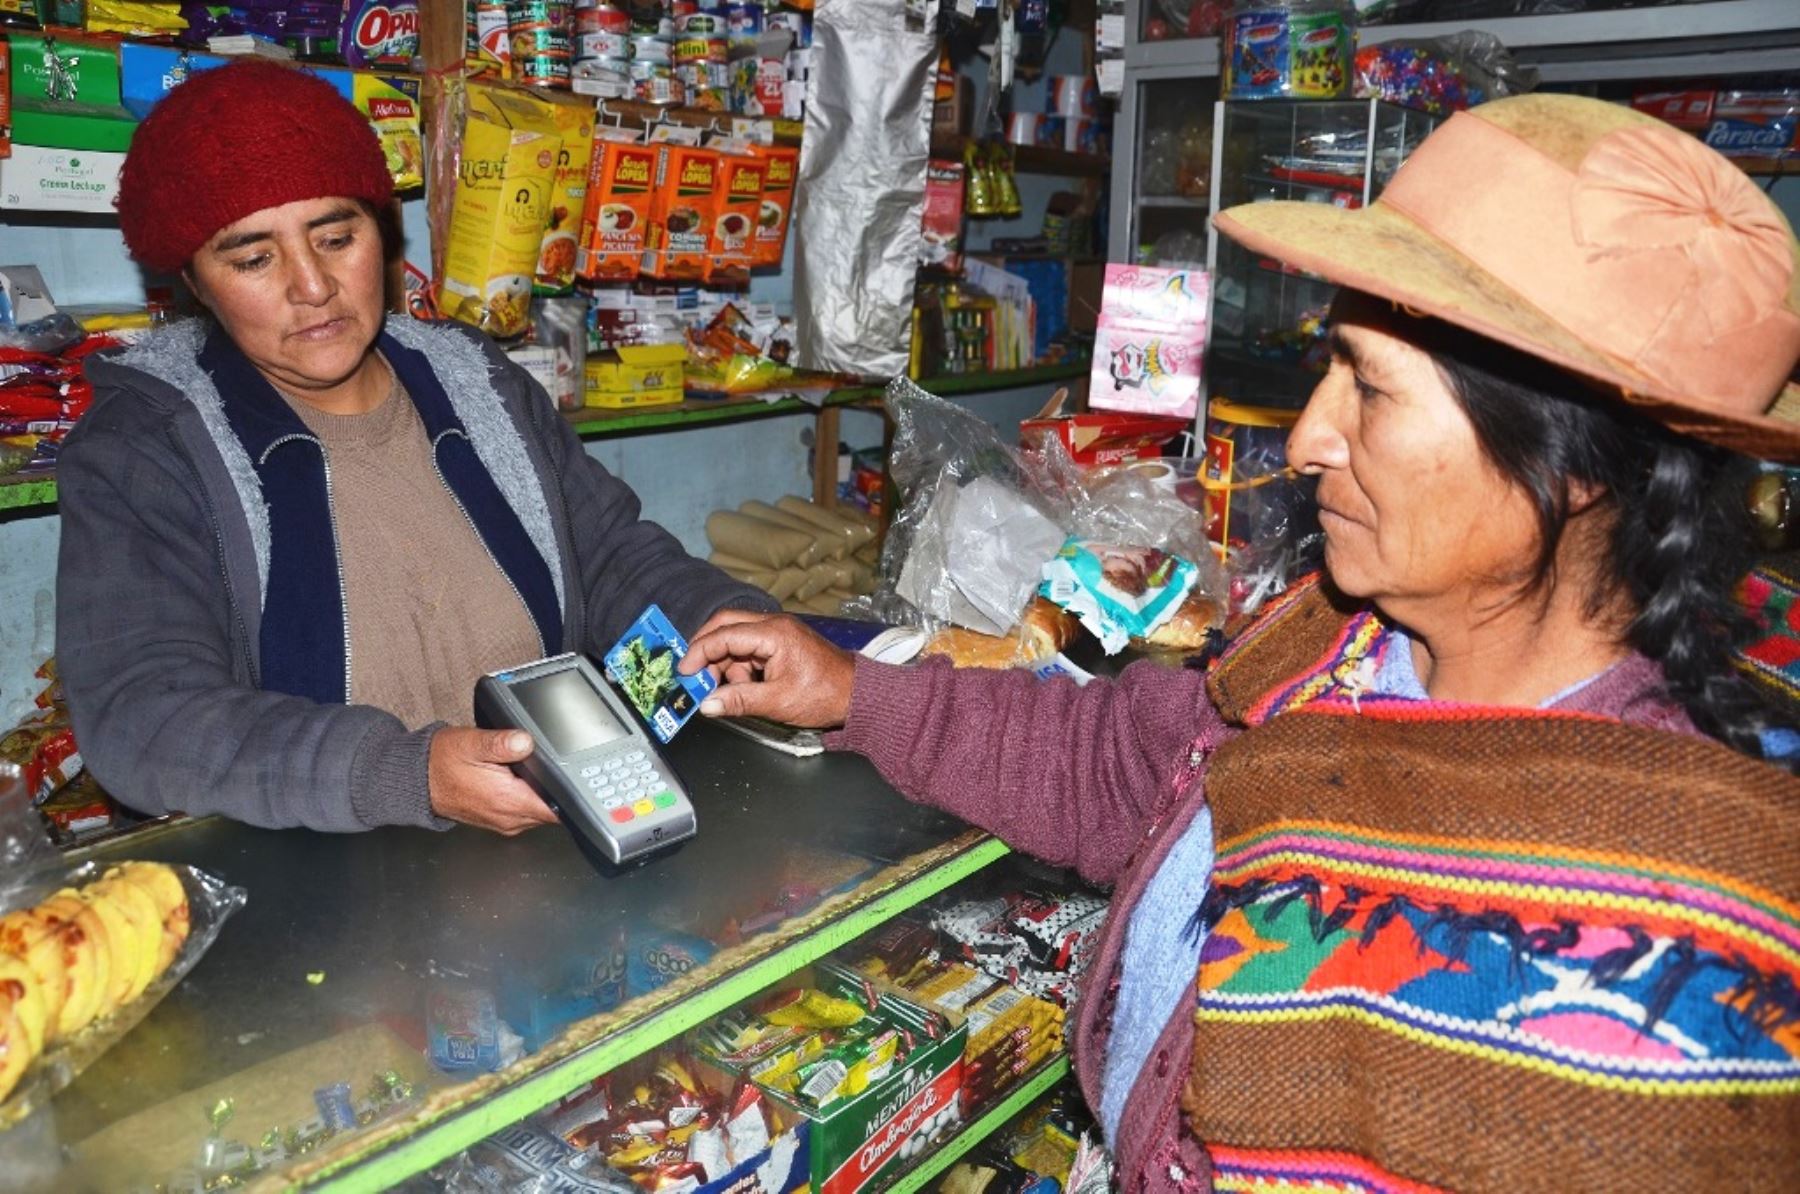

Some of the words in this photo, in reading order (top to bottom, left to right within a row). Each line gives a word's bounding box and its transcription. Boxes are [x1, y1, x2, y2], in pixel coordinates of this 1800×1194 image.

[1706, 120, 1788, 145] Paracas
[657, 712, 676, 732] VISA
[865, 1063, 934, 1138] MENTITAS
